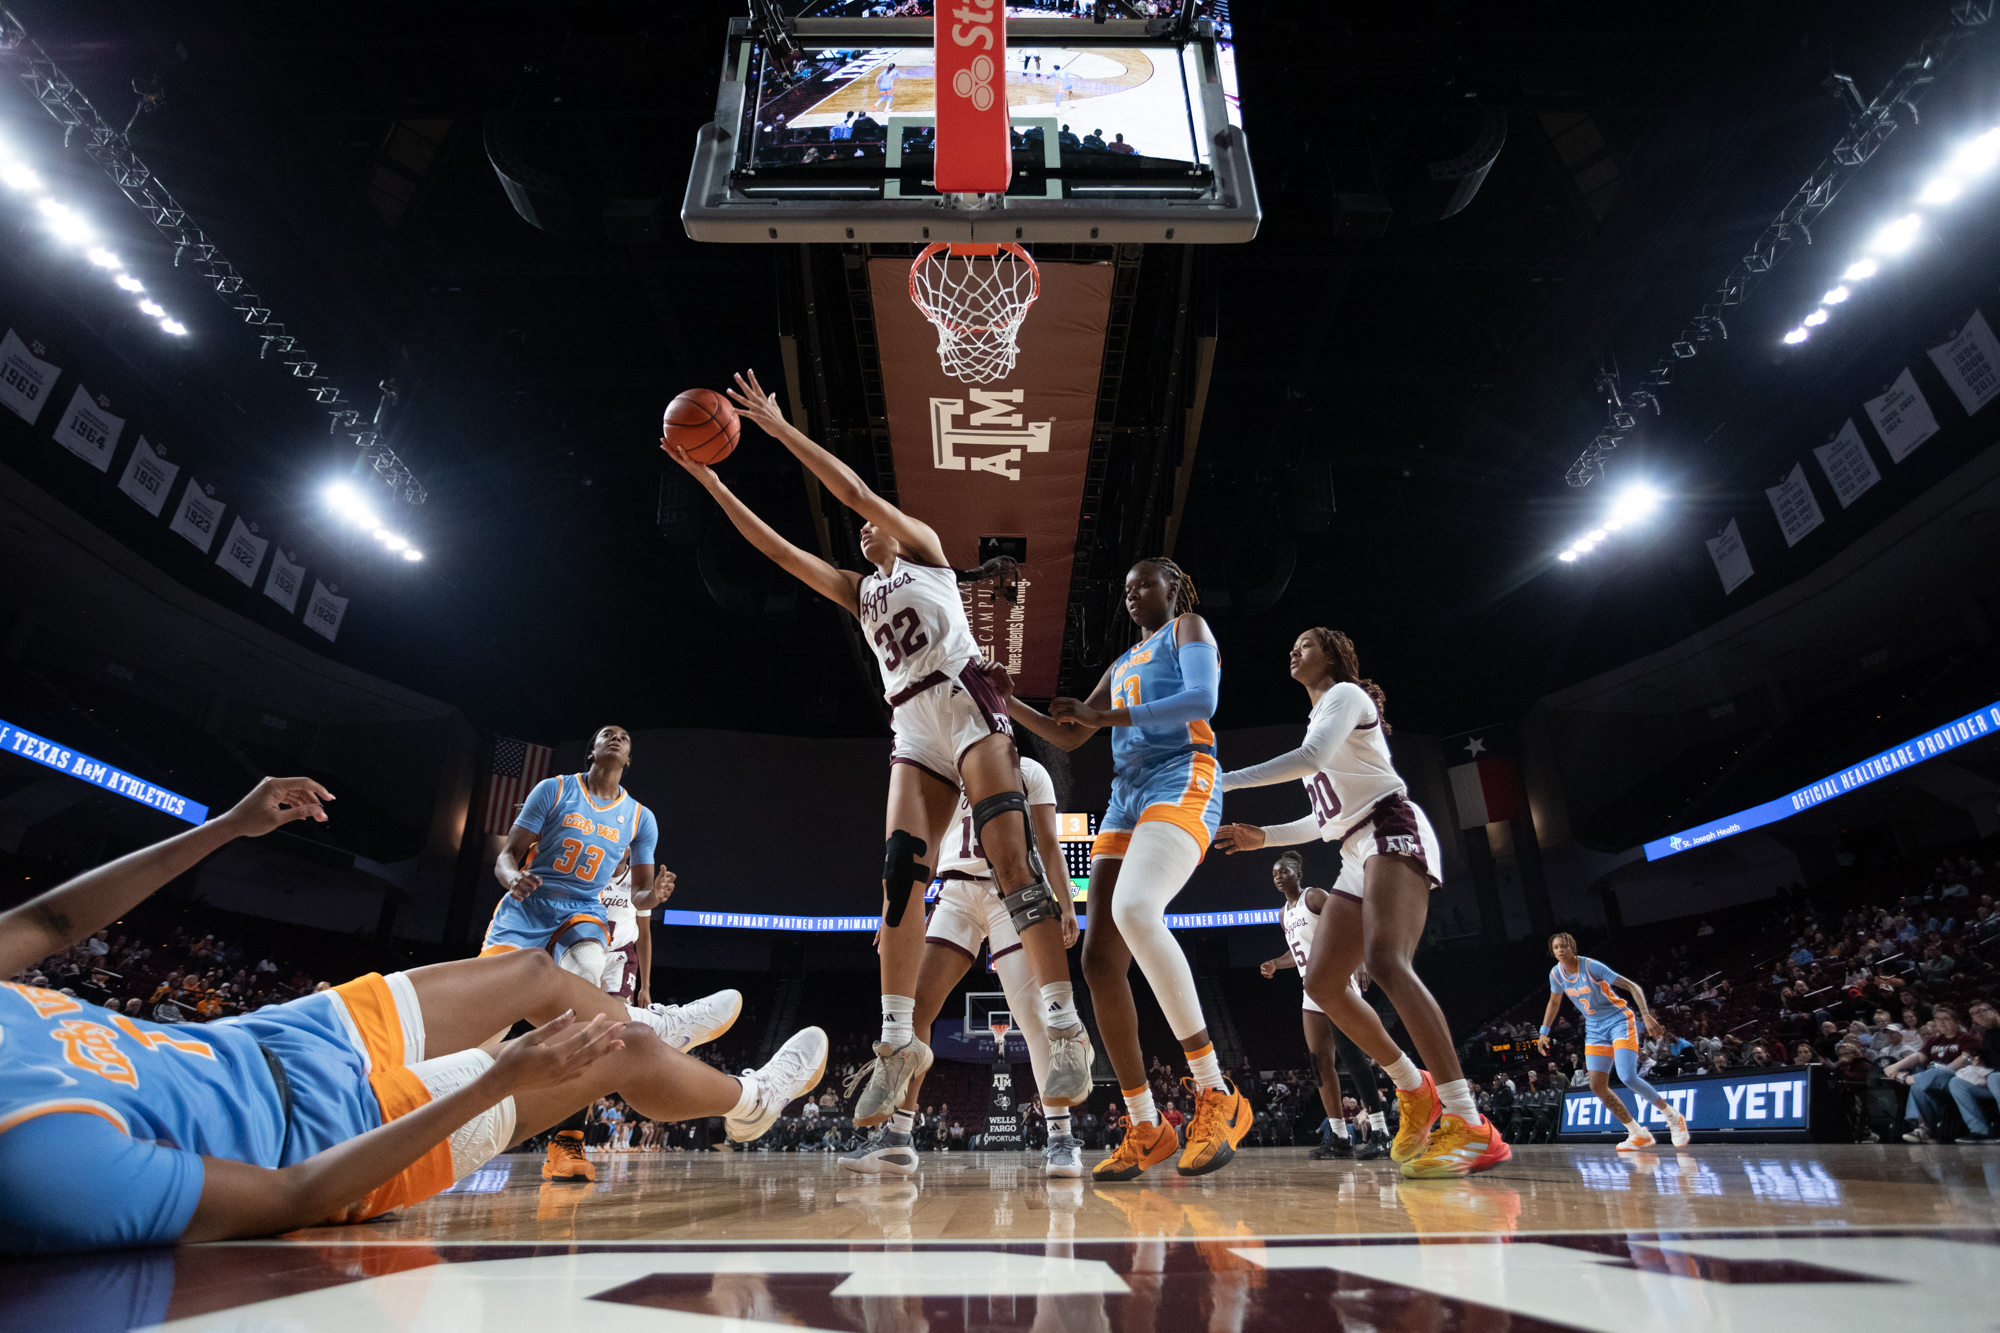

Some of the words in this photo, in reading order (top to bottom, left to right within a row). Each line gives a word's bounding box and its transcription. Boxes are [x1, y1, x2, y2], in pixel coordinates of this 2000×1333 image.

[0, 363, 39, 401] 1969
[70, 416, 105, 450] 1964
[133, 465, 161, 495] 1951
[184, 505, 212, 534] 1923
[230, 542, 255, 569] 1922
[862, 572, 916, 623] Aggies
[313, 603, 337, 625] 1920
[874, 607, 929, 672] 32
[1005, 623, 1024, 653] students
[12, 732, 71, 769] TEXAS
[71, 757, 107, 784] A&M
[107, 772, 186, 815] ATHLETICS
[1791, 779, 1839, 810] OFFICIAL
[1840, 745, 1916, 790] HEALTHCARE
[1916, 714, 1989, 758] PROVIDER
[561, 812, 596, 836] Lady
[597, 823, 620, 844] Vols
[1069, 817, 1080, 832] 3
[1682, 838, 1692, 849] St.
[1692, 831, 1716, 847] Joseph
[1716, 823, 1741, 838] Health
[552, 837, 606, 882] 33
[699, 913, 723, 925] YOUR
[727, 915, 769, 927] PRIMARY
[773, 917, 813, 930] PARTNER
[817, 919, 834, 930] FOR
[838, 918, 878, 930] PRIMARY
[1173, 914, 1213, 927] PARTNER
[1217, 914, 1234, 925] FOR
[1238, 911, 1280, 924] PRIMARY
[1579, 998, 1596, 1015] 2
[1565, 1097, 1612, 1126] YETI
[1634, 1089, 1694, 1123] YETI
[1723, 1080, 1803, 1120] YETI
